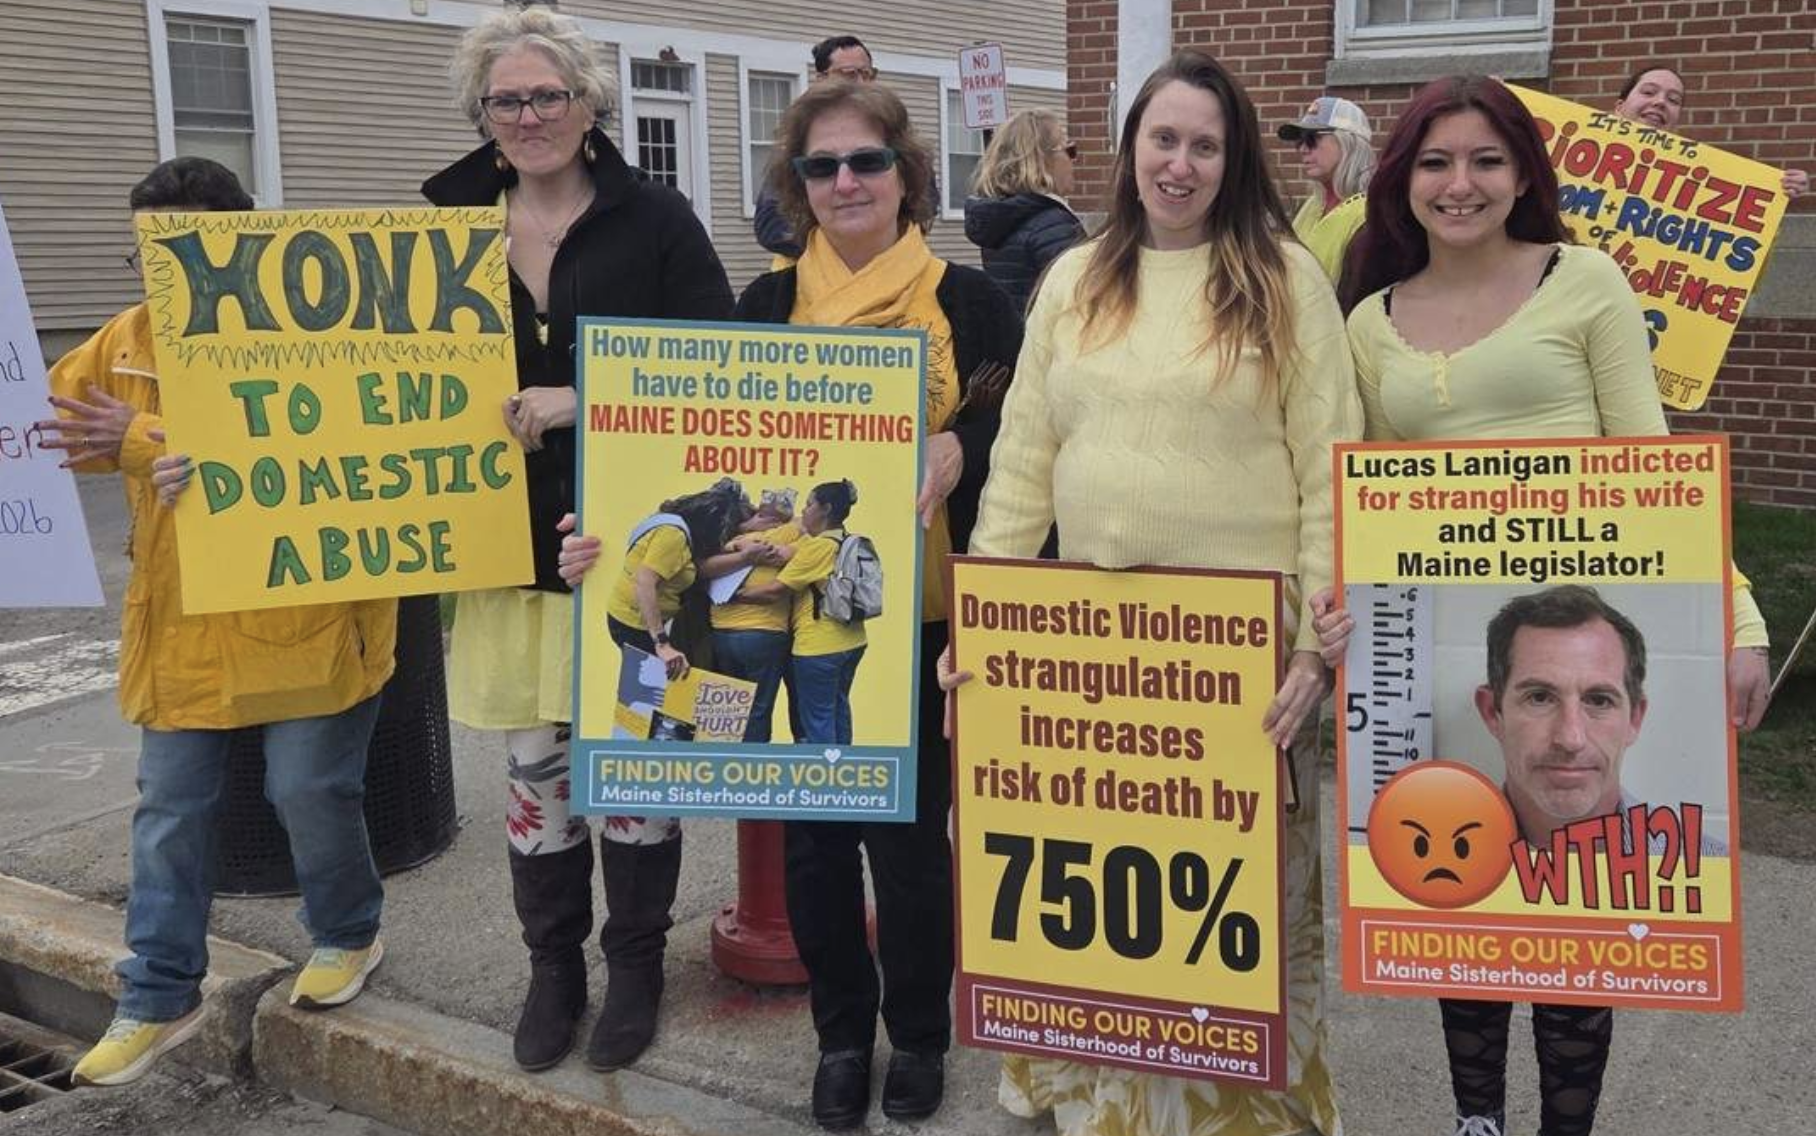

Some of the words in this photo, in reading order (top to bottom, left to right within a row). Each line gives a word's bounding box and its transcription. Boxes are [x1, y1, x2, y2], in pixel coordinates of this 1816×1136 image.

[973, 53, 989, 70] NO
[963, 72, 1005, 91] PARKING
[1587, 113, 1632, 135] IT'S
[1589, 225, 1618, 242] OF
[154, 228, 507, 337] HONK
[591, 329, 650, 358] How
[658, 338, 732, 367] many
[740, 341, 808, 365] more
[816, 344, 913, 368] women
[633, 367, 697, 398] have
[703, 372, 731, 399] to
[737, 372, 778, 401] die
[786, 373, 873, 405] before
[230, 379, 322, 437] TO
[356, 371, 469, 425] END
[590, 404, 675, 435] MAINE
[682, 407, 751, 438] DOES
[759, 410, 913, 443] SOMETHING
[199, 441, 512, 515] DOMESTIC
[684, 445, 773, 475] ABOUT
[779, 448, 819, 476] IT?
[1347, 453, 1436, 478] Lucas
[1445, 449, 1571, 481] Lanigan
[1580, 446, 1715, 474] indicted
[1357, 485, 1400, 511] for
[1408, 483, 1569, 515] strangling
[1578, 482, 1626, 509] his
[1634, 481, 1705, 508] wife
[0, 499, 53, 534] 026
[1438, 517, 1496, 543] and
[1506, 517, 1595, 543] STILL
[1601, 522, 1619, 542] a
[267, 520, 456, 588] ABUSE
[1398, 551, 1491, 577] Maine
[1500, 549, 1665, 584] legislator!
[961, 593, 1111, 638] Domestic
[1119, 602, 1268, 647] Violence
[1405, 608, 1415, 621] 5
[1405, 627, 1415, 642] 4
[1405, 648, 1415, 662] 3
[986, 650, 1241, 705] strangulation
[1405, 669, 1415, 680] 2
[692, 716, 748, 732] HURT
[1347, 692, 1369, 732] 5
[1021, 705, 1204, 761] increases
[1404, 748, 1419, 760] 10
[600, 759, 715, 784] FINDING
[723, 763, 781, 786] OUR
[791, 764, 889, 788] VOICES
[601, 785, 662, 802] Maine
[668, 786, 771, 806] Sisterhood
[775, 789, 795, 806] of
[799, 790, 887, 808] Survivors
[973, 758, 1042, 803] risk
[1050, 766, 1086, 808] of
[1095, 769, 1203, 819] death
[1213, 779, 1260, 833] by
[1510, 802, 1703, 914] WTH?!
[984, 832, 1260, 972] 750%
[1374, 930, 1501, 961] FINDING
[1510, 936, 1580, 965] OUR
[1588, 939, 1709, 970] VOICES
[1376, 959, 1443, 981] Maine
[1449, 963, 1567, 988] Sisterhood
[1574, 969, 1596, 988] of
[1602, 971, 1708, 994] Survivors
[982, 994, 1087, 1030] FINDING
[1094, 1011, 1151, 1041] OUR
[1158, 1018, 1259, 1054] VOICES
[984, 1020, 1039, 1042] Maine
[1044, 1029, 1140, 1058] Sisterhood
[1146, 1044, 1165, 1060] of
[1170, 1048, 1258, 1074] Survivors
